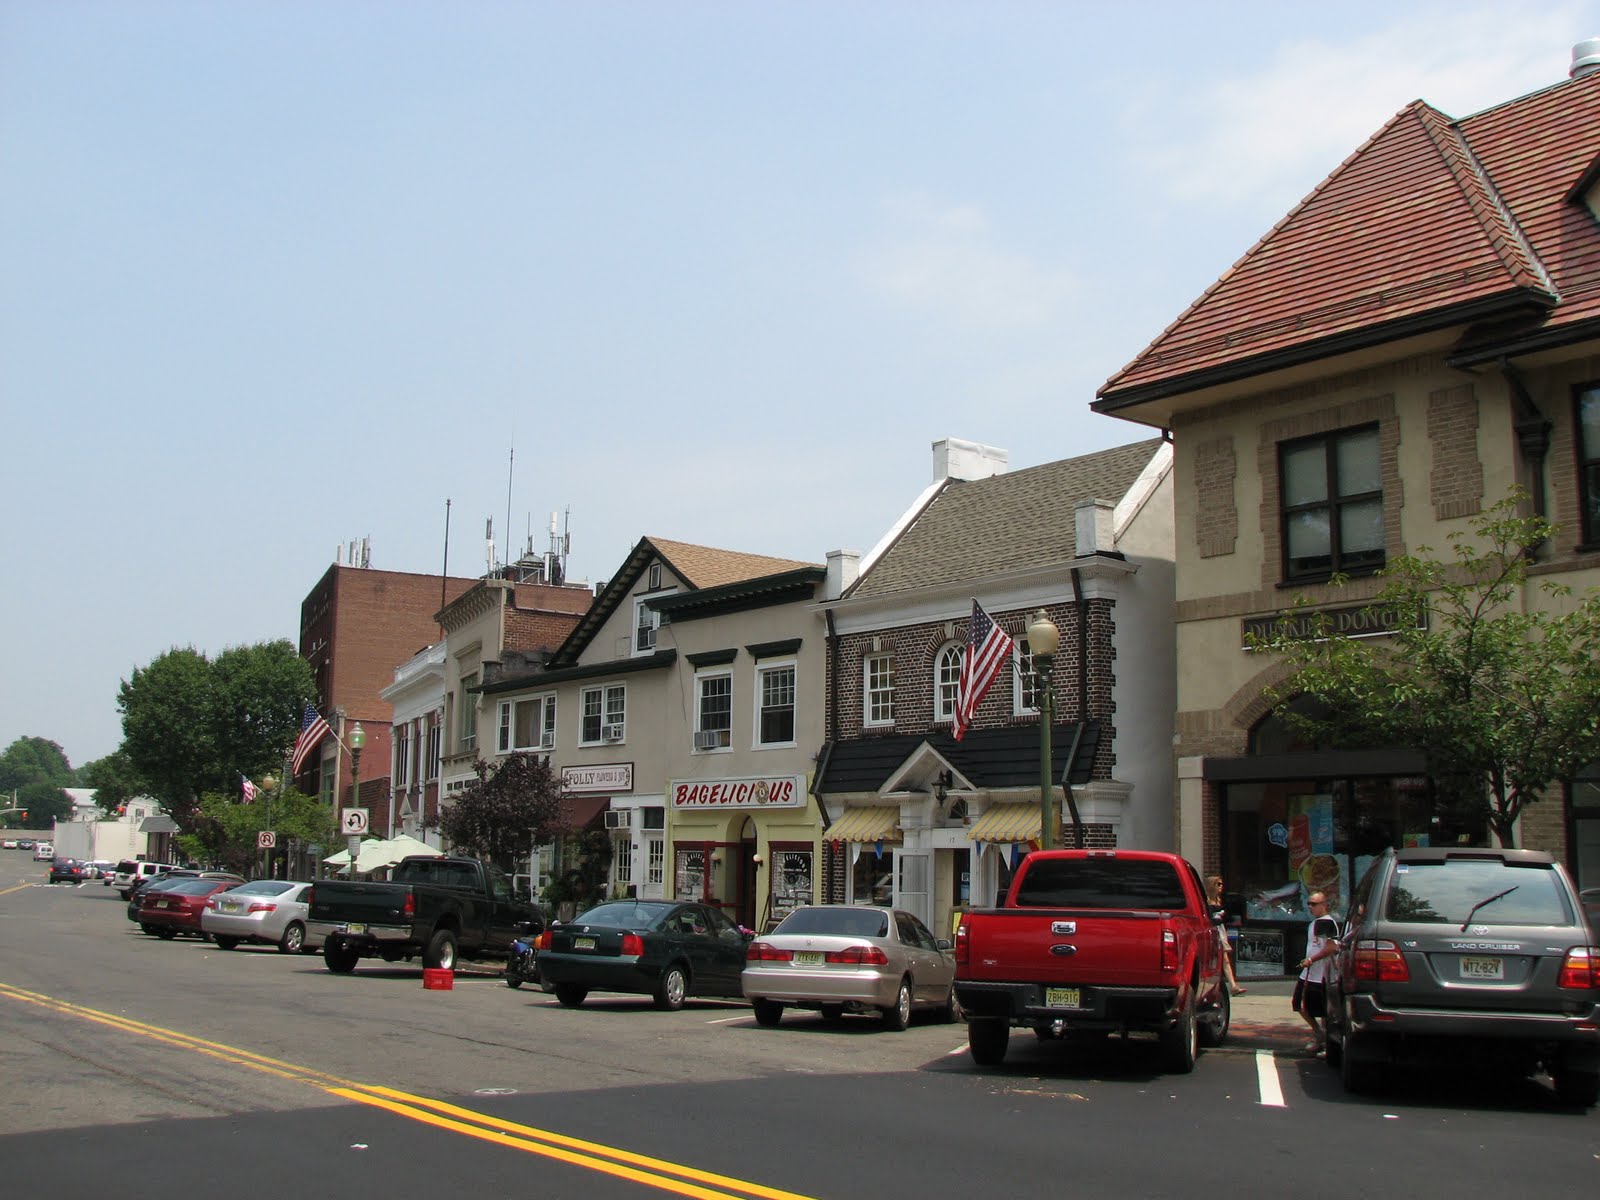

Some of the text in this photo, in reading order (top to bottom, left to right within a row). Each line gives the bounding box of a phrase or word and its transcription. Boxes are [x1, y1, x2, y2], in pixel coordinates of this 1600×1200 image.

[569, 772, 595, 785] FOLLY
[675, 780, 793, 806] BAGELICIOUS
[1478, 943, 1520, 951] CRUISER
